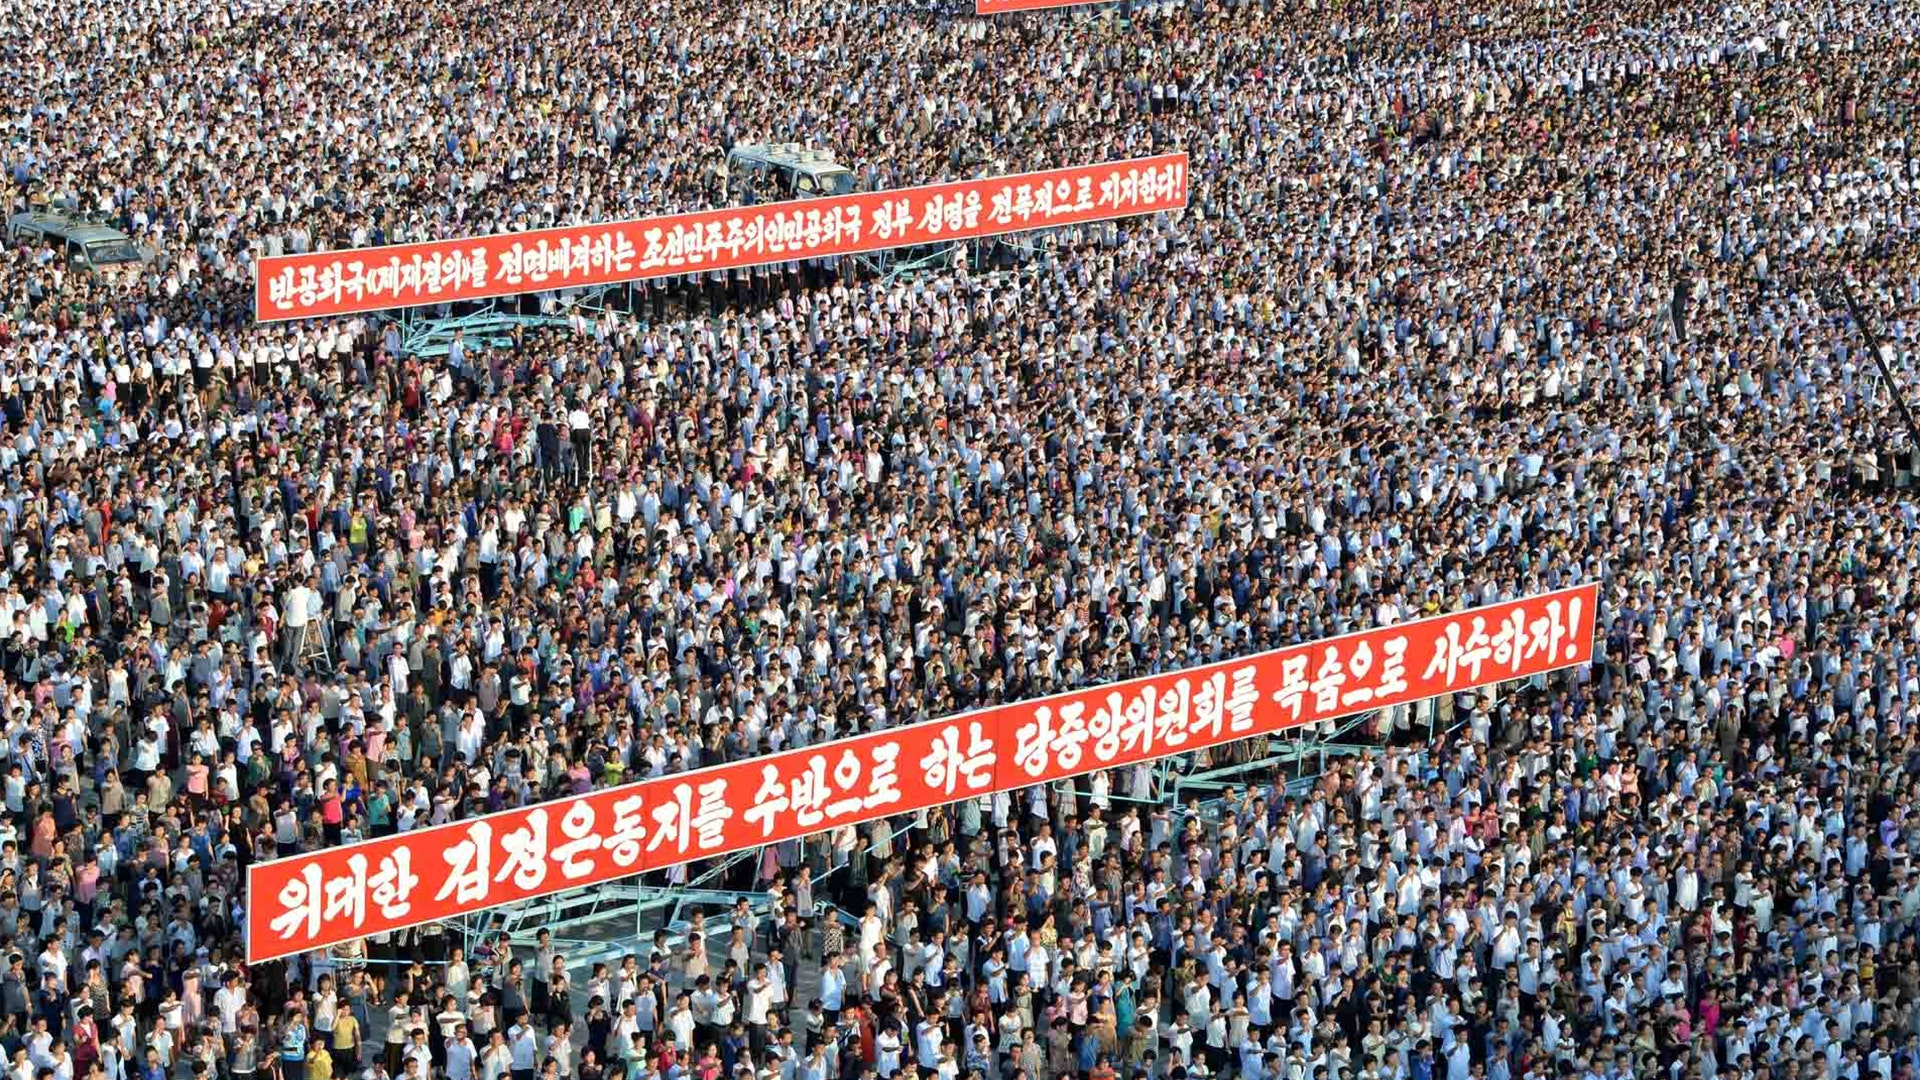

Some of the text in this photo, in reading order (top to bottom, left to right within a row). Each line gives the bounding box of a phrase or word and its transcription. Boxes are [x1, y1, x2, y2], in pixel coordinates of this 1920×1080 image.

[493, 230, 637, 285] 전면배격하는
[638, 204, 863, 270] 조선민주주의인민공화국
[869, 197, 914, 240] 정부
[916, 189, 983, 235] 성명을
[987, 175, 1095, 225] 전폭적으로
[1097, 162, 1184, 210] 지지한다!
[269, 596, 1582, 940] 위대한 김정은동지를 수반으로 하는 당중앙위원회를 목숨으로 사수하자!
